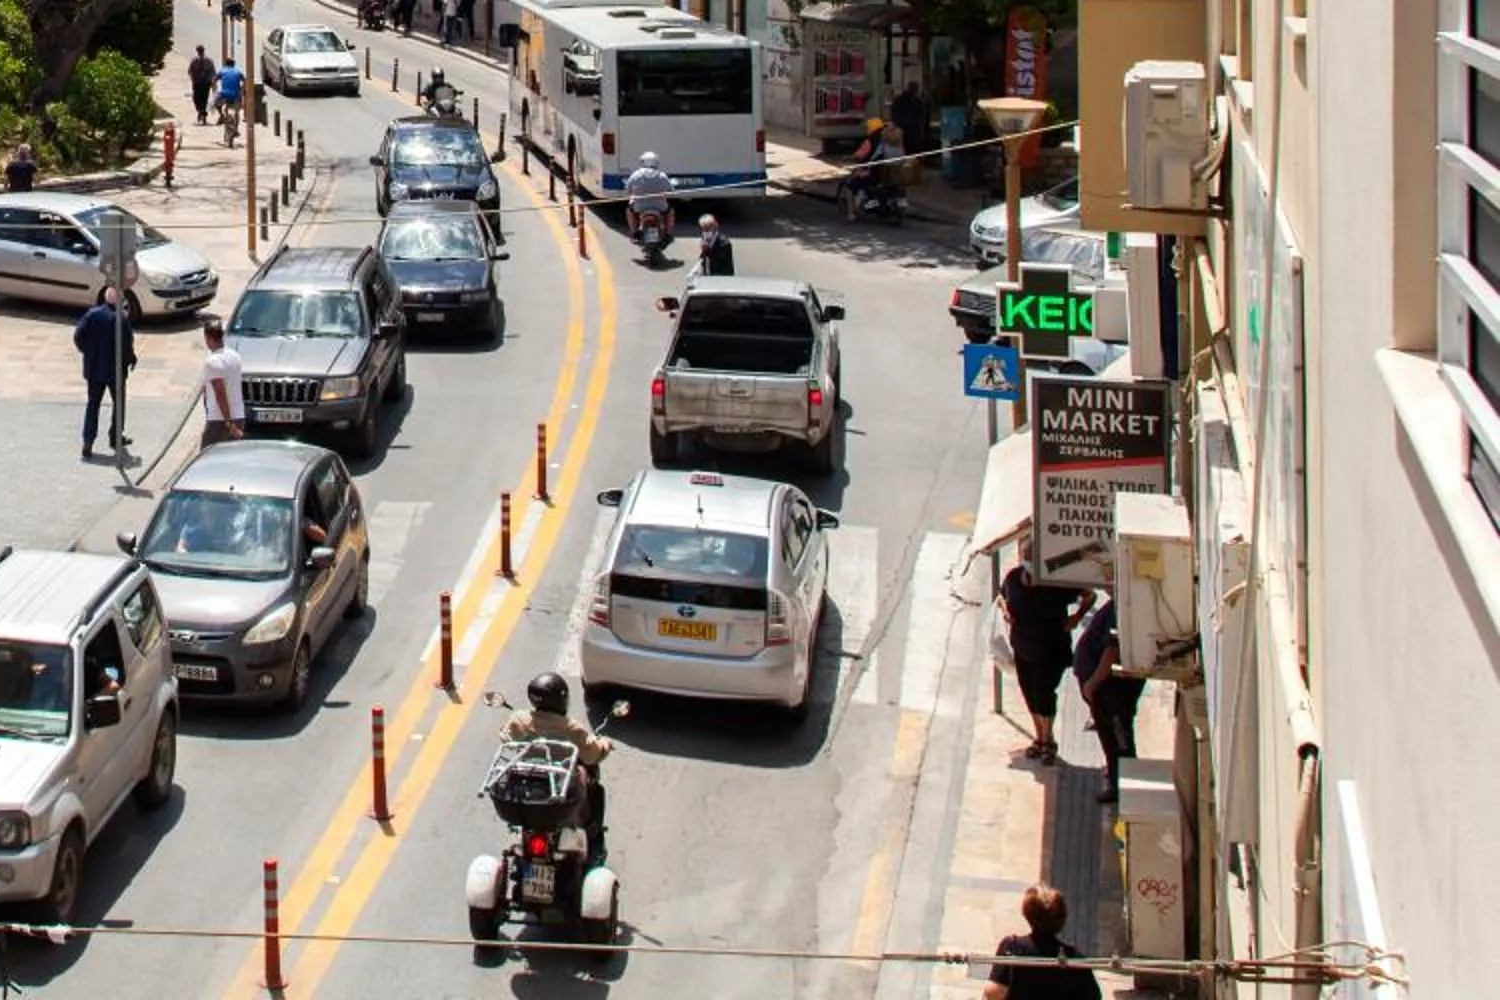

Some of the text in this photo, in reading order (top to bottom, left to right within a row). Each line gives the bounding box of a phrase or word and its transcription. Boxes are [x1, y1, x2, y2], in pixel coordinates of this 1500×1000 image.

[999, 293, 1093, 332] ΚΕΙ
[1067, 387, 1133, 411] MINI
[1043, 409, 1160, 436] MARKET
[1059, 507, 1115, 524] ΠΑΙΧΝΙ
[1048, 523, 1116, 539] ΦΩΤΟΤΥ
